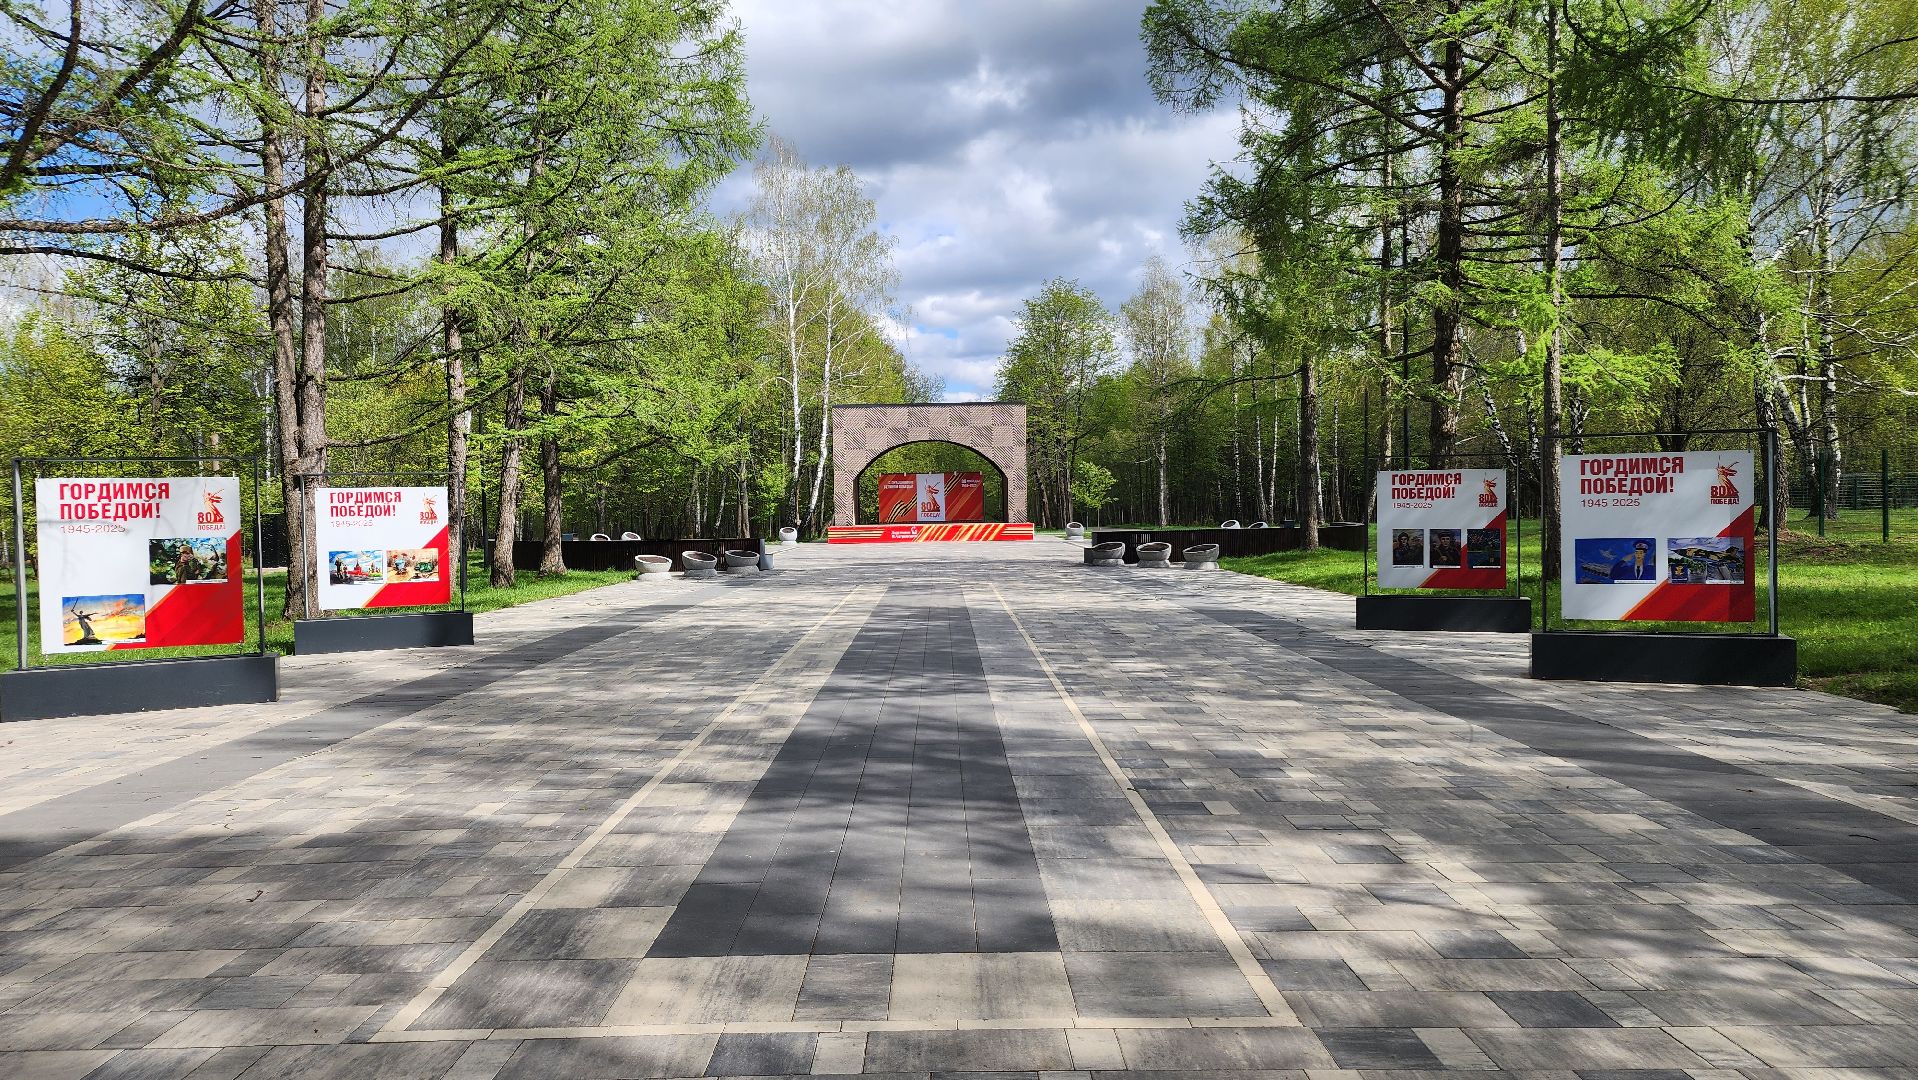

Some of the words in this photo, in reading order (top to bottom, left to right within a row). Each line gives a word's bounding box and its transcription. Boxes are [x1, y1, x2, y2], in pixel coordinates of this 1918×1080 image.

[1580, 457, 1684, 477] ГОРДИМСЯ
[1391, 473, 1462, 487] ГОРДИМСЯ
[1580, 474, 1674, 496] ПОБЕДОЙ!
[59, 482, 170, 502] ГОРДИМСЯ
[329, 491, 402, 505] ГОРДИМСЯ
[1391, 485, 1455, 500] ПОБЕДОЙ!
[1710, 486, 1726, 497] 80
[60, 500, 161, 521] ПОБЕДОЙ!
[197, 512, 212, 523] 80
[330, 504, 396, 518] ПОБЕДОЙ!
[60, 524, 126, 534] 1945-2025
